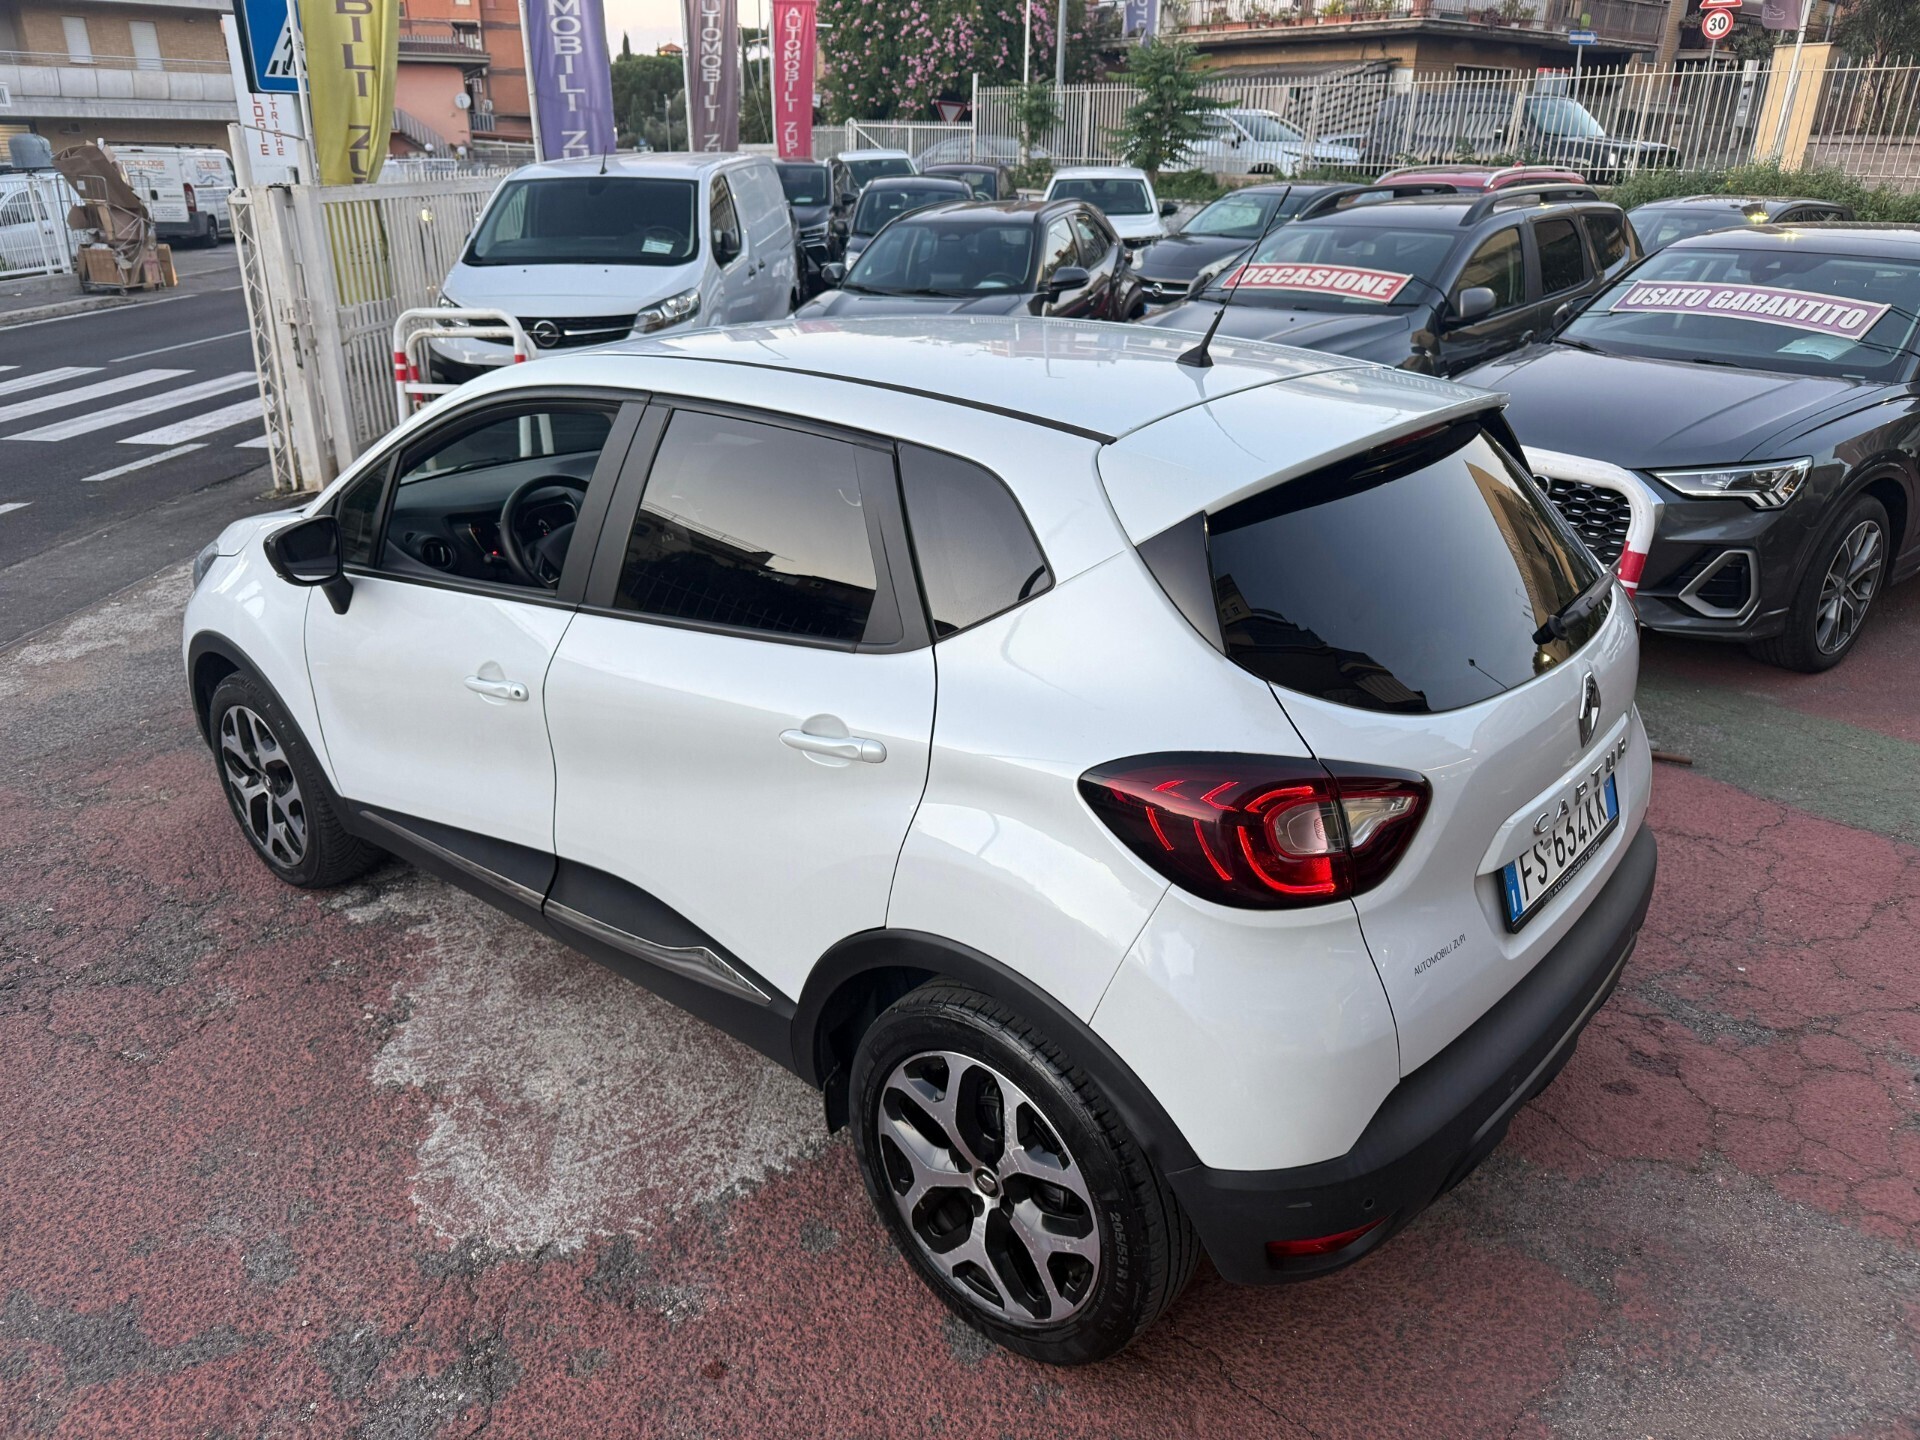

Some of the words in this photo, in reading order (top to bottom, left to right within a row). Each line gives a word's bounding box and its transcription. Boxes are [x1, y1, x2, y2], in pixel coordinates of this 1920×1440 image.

[1709, 16, 1727, 31] 30
[548, 0, 586, 112] MOBILI
[784, 7, 802, 112] AUTOMOBILI
[1234, 267, 1397, 296] OCCASIONE
[1626, 288, 1708, 308] USATO
[1706, 290, 1868, 330] GARANTITO
[1533, 736, 1627, 836] CAPTUR
[1413, 943, 1453, 977] AUTOMOBILI
[1452, 933, 1466, 950] ZUPI
[1109, 1211, 1129, 1265] 205/55
